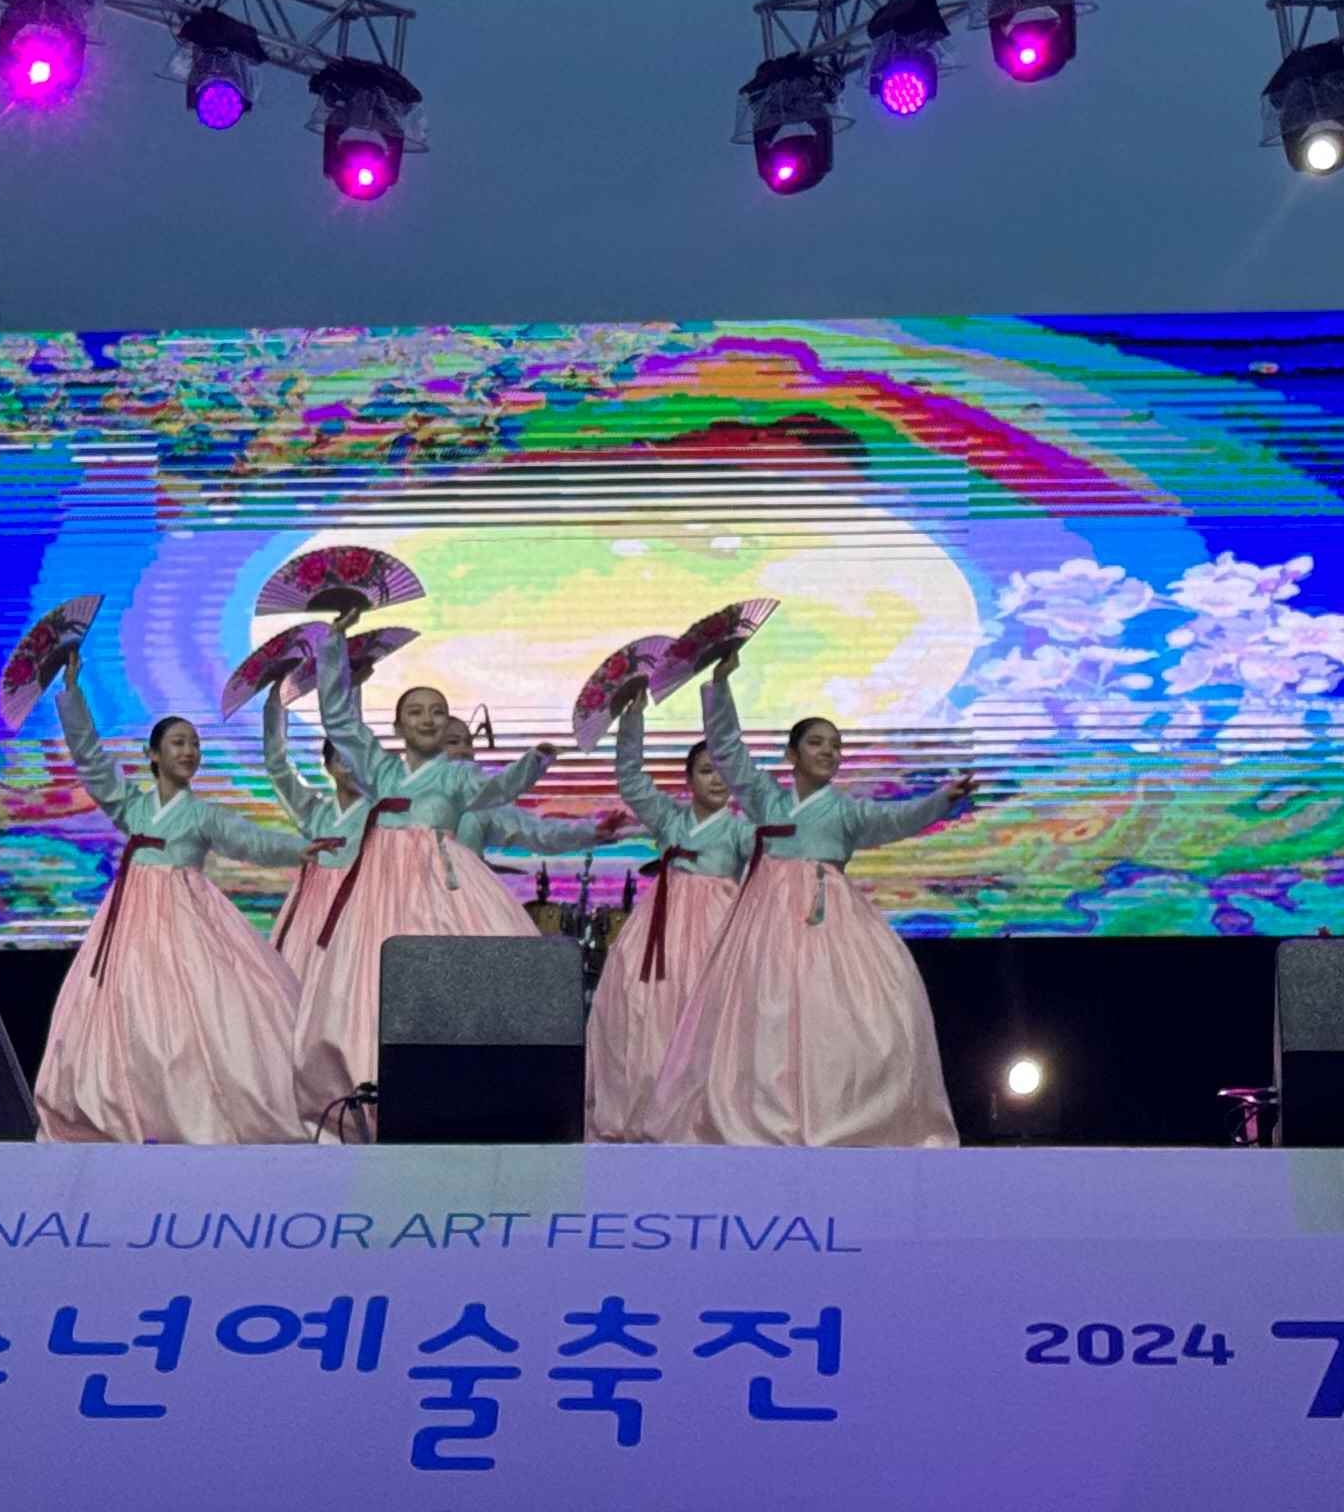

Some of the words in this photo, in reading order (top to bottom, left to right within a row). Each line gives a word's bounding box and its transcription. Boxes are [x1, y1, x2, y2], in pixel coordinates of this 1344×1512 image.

[125, 1211, 376, 1251] JUNIOR
[387, 1211, 533, 1251] ART
[545, 1212, 864, 1254] FESTIVAL
[1023, 1321, 1237, 1368] 2024
